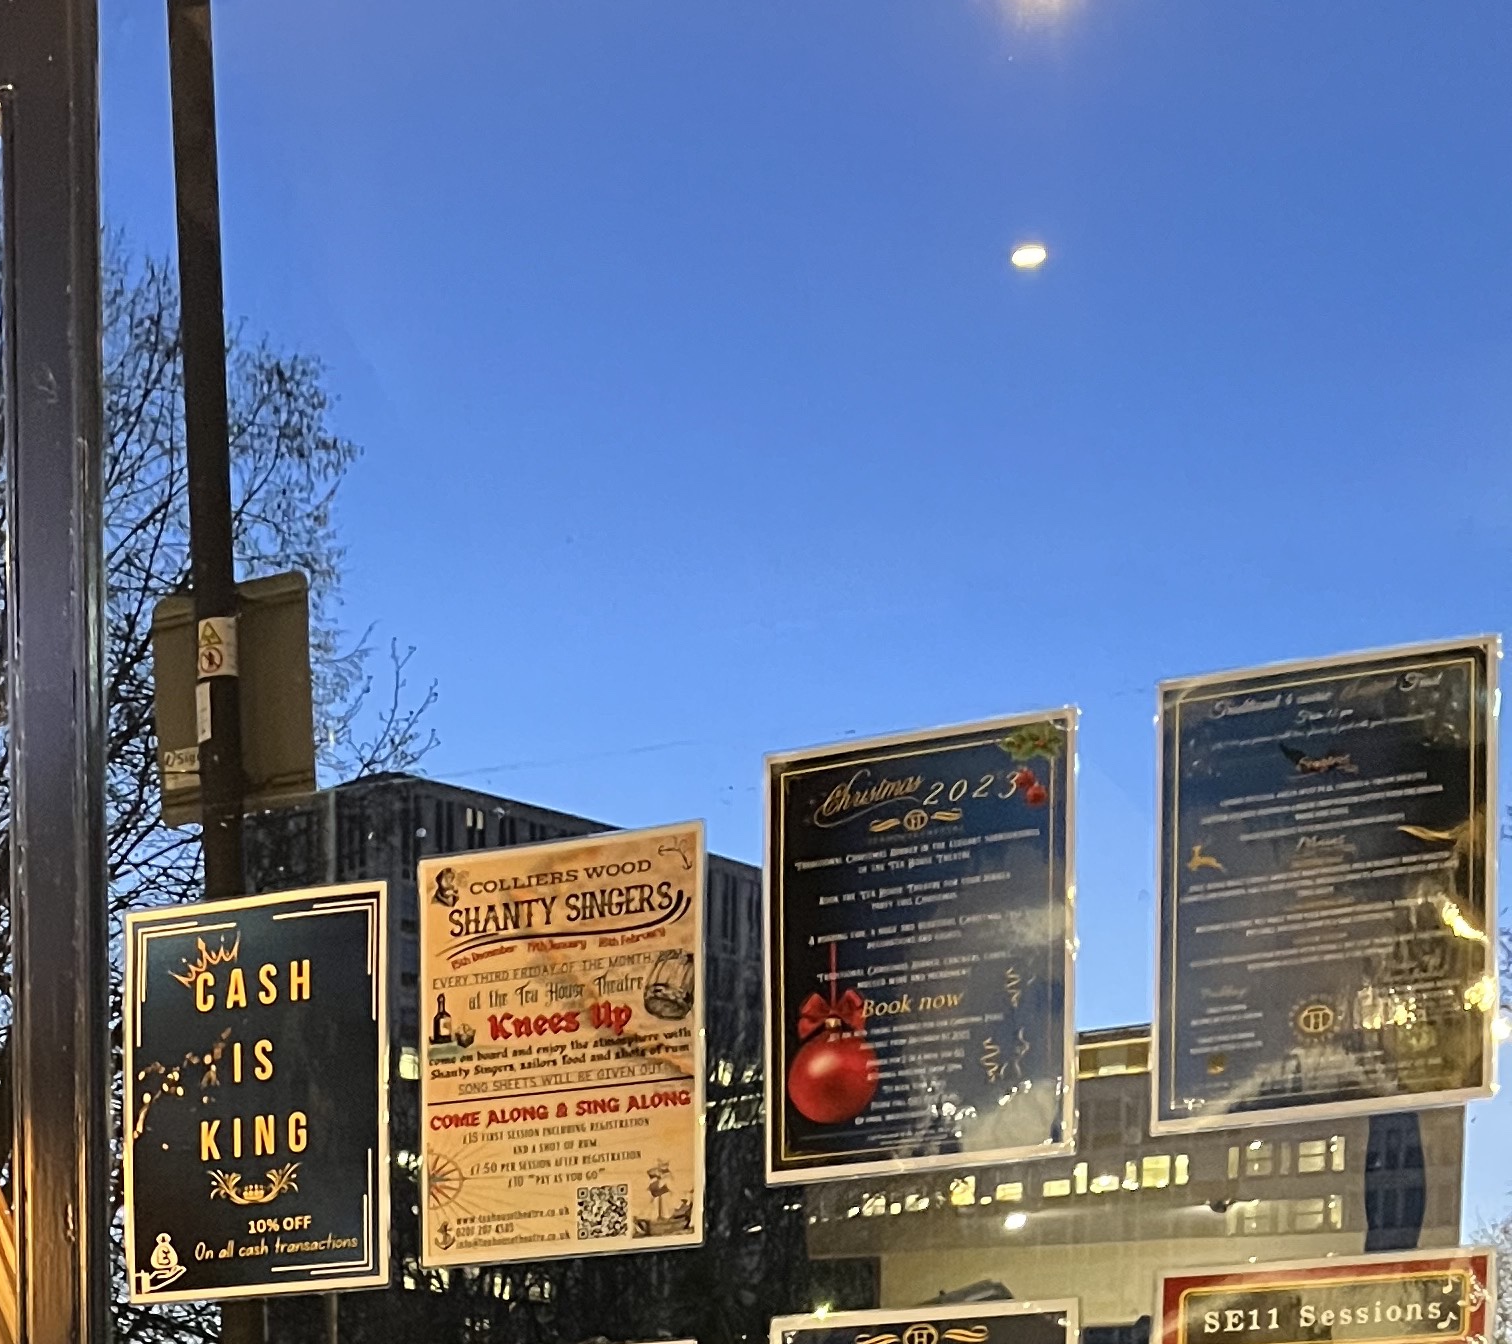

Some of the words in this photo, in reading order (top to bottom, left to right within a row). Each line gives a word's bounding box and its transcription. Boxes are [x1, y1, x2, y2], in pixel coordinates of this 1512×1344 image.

[817, 769, 924, 822] Christmas
[923, 771, 1020, 806] 2023
[470, 869, 579, 895] COLLIERS
[584, 859, 652, 879] WOOD
[448, 896, 556, 937] SHANTY
[565, 881, 673, 922] SINGERS
[472, 945, 518, 962] December
[620, 928, 666, 946] February
[196, 959, 310, 1012] CASH
[433, 976, 472, 990] EVERY
[473, 972, 509, 984] THIRD
[513, 965, 558, 979] FRIDAY
[561, 962, 575, 973] OF
[582, 958, 603, 971] THE
[468, 991, 482, 1010] at
[489, 989, 507, 1008] the
[514, 981, 538, 1006] Tea
[546, 982, 585, 1008] House
[594, 970, 644, 997] Theatre
[487, 1008, 581, 1041] Knees
[590, 1000, 632, 1036] Up
[861, 994, 911, 1018] Book
[918, 992, 962, 1010] now
[233, 1039, 273, 1083] IS
[430, 1064, 469, 1081] Shanty
[520, 1055, 557, 1070] sailors
[562, 1051, 586, 1065] food
[591, 1048, 611, 1062] and
[477, 1045, 508, 1062] board
[512, 1044, 532, 1057] and
[536, 1040, 566, 1058] enjoy
[570, 1040, 588, 1051] the
[458, 1082, 489, 1096] SONG
[493, 1076, 537, 1092] SHEETS
[542, 1072, 573, 1086] WILL
[577, 1069, 592, 1082] BE
[596, 1065, 636, 1081] GIVEN
[640, 1062, 665, 1076] OUT
[430, 1109, 481, 1131] COME
[487, 1102, 549, 1128] ALONG
[556, 1103, 568, 1118] &
[575, 1095, 620, 1117] SING
[625, 1090, 691, 1114] ALONG
[200, 1111, 308, 1161] KING
[481, 1128, 504, 1142] FIRST
[507, 1126, 539, 1140] SESSION
[543, 1123, 587, 1136] INCLUDING
[590, 1117, 649, 1132] REGISTRATION
[500, 1161, 516, 1173] PER
[518, 1157, 551, 1172] SESSION
[555, 1156, 578, 1167] AFTER
[582, 1150, 641, 1164] REGISTRATION
[513, 1144, 529, 1154] AND
[539, 1142, 560, 1152] SHOT
[578, 1139, 597, 1149] RUM
[566, 1170, 583, 1182] YOU
[248, 1218, 280, 1234] 10%
[283, 1215, 312, 1231] OFF
[195, 1241, 213, 1261] On
[219, 1239, 234, 1259] all
[238, 1237, 269, 1257] cash
[275, 1232, 358, 1253] transactions
[1204, 1307, 1280, 1334] SE11
[1299, 1301, 1442, 1327] Sessions
